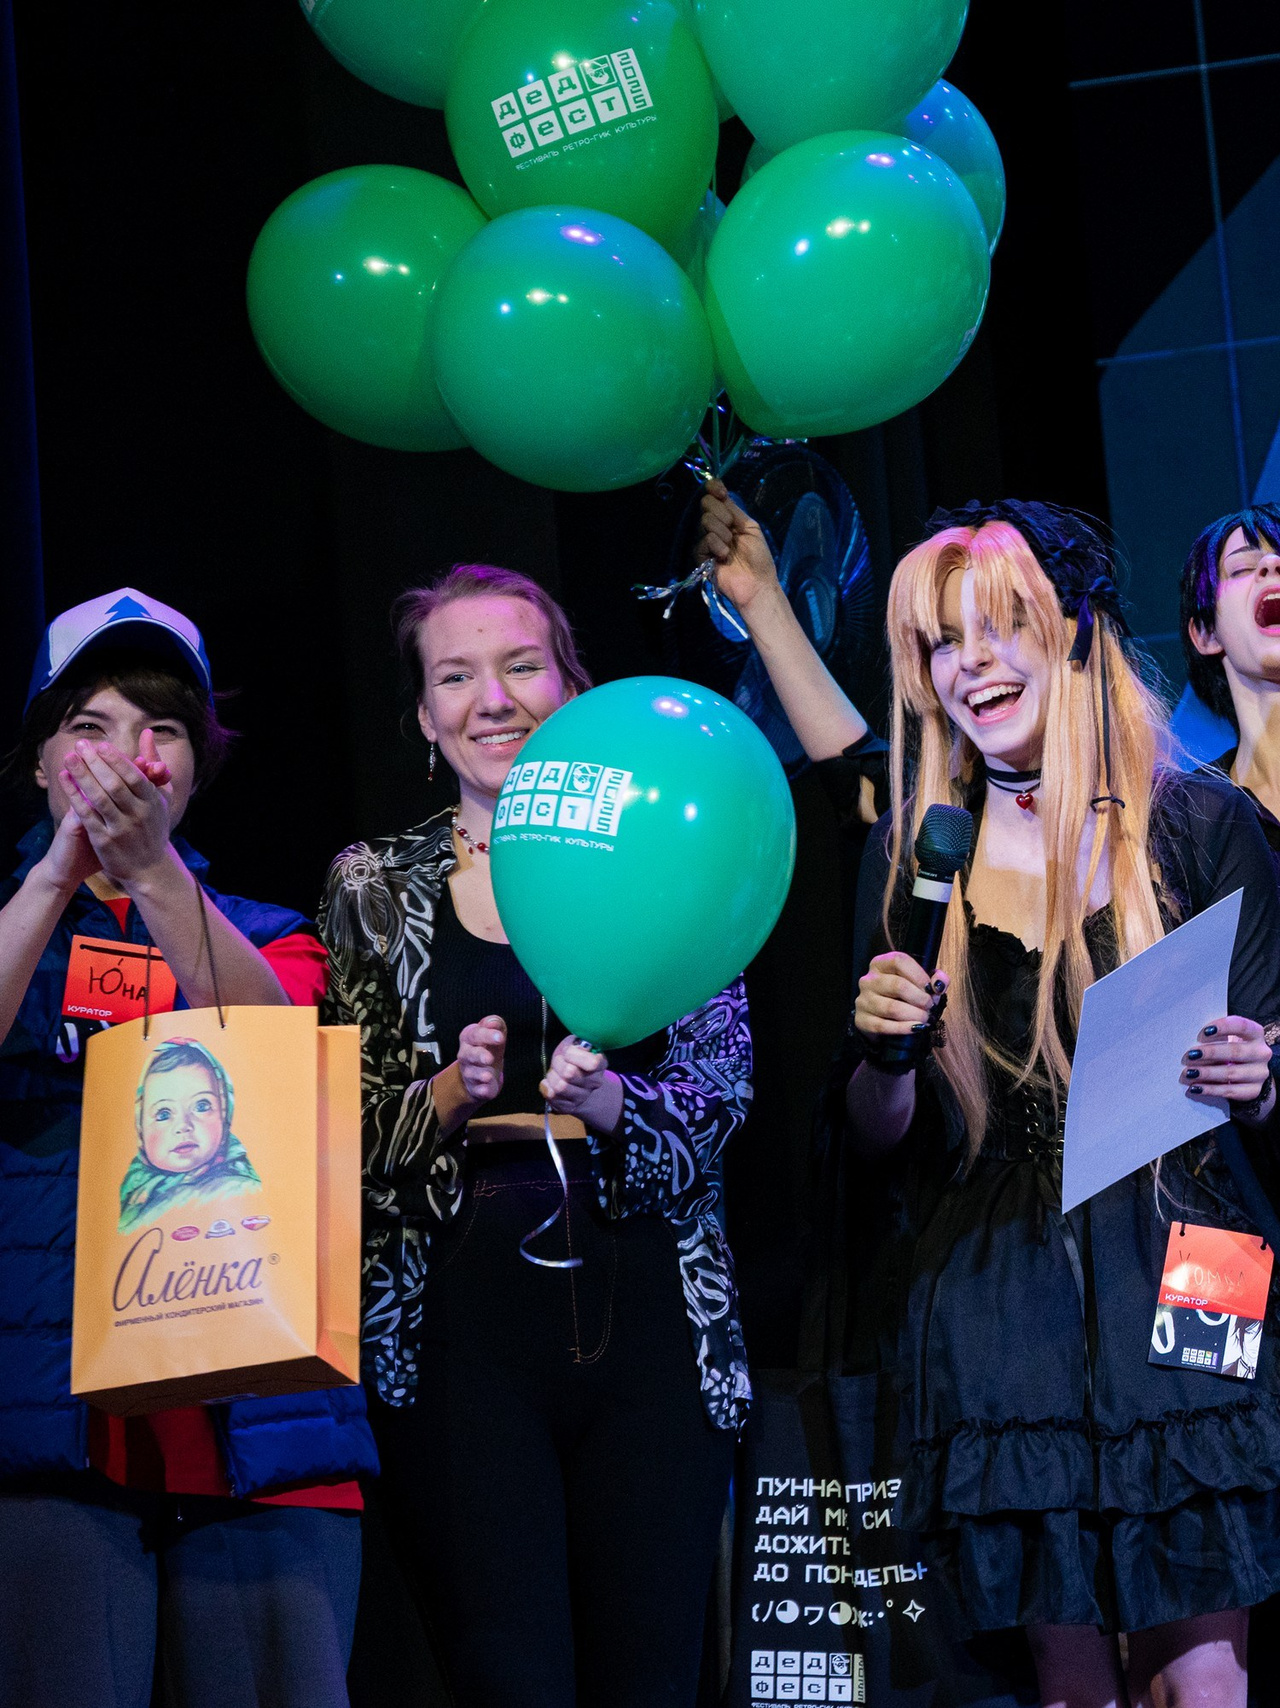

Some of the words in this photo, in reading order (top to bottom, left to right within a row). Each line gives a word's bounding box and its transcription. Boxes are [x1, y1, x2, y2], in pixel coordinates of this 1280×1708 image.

[614, 50, 650, 110] 2025
[562, 130, 611, 152] РЕТРО-ГИК
[615, 115, 657, 134] КУЛЬТУРЫ
[596, 770, 625, 833] 2025
[67, 1004, 113, 1017] КУРАТОР
[113, 1227, 263, 1312] Алёнка
[165, 1302, 226, 1319] КОНДИТЕРСКИЙ
[1165, 1293, 1209, 1306] КУРАТОР
[755, 1504, 809, 1526] ДАЙ
[753, 1563, 789, 1583] ДО
